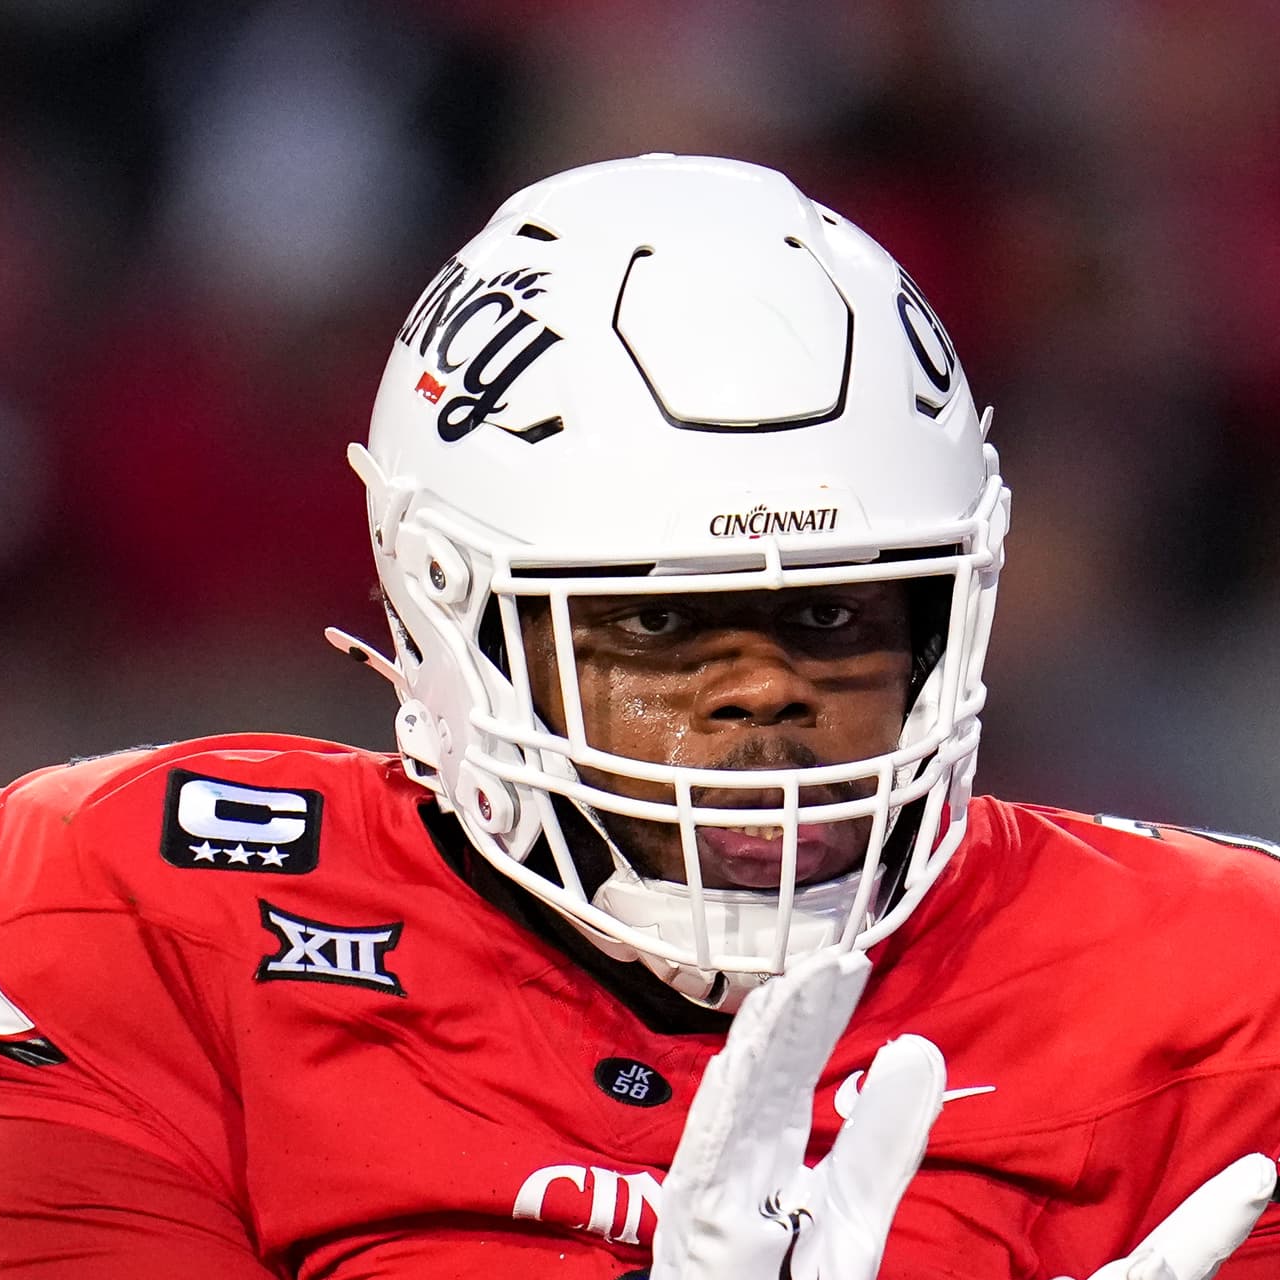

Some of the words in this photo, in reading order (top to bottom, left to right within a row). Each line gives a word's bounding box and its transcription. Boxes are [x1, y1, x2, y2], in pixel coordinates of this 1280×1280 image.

[710, 508, 838, 537] CINCINNATI
[178, 779, 308, 845] C
[266, 910, 393, 981] XII
[611, 1075, 650, 1100] 58
[618, 1064, 654, 1085] JK
